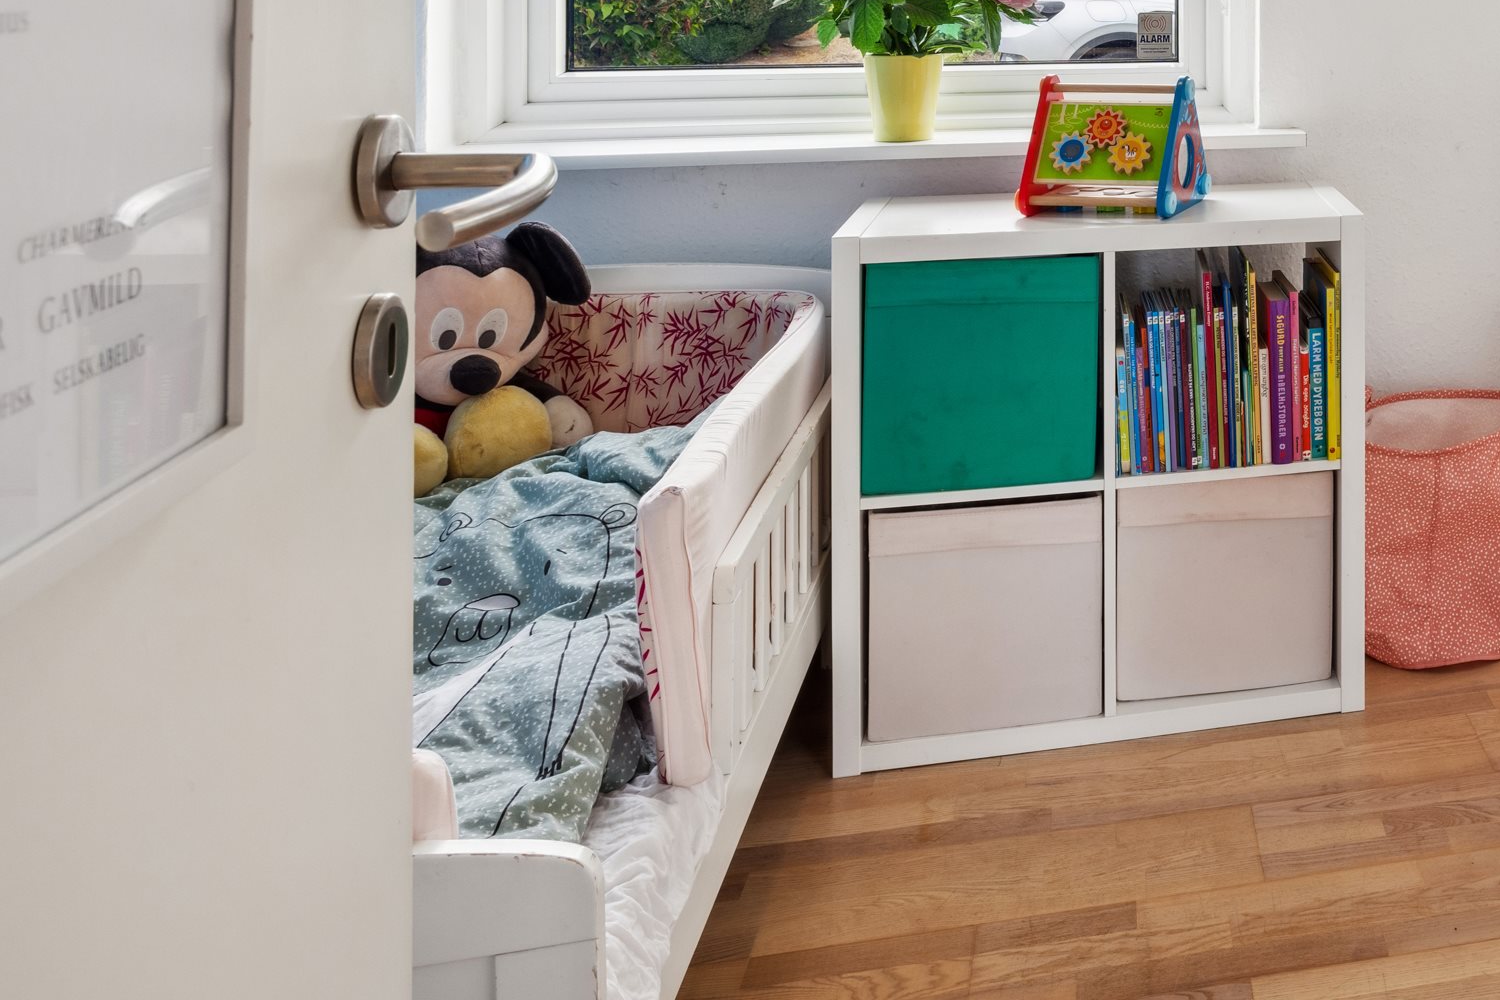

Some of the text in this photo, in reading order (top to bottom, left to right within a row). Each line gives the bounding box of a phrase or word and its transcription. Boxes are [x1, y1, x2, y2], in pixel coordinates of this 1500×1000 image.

[1140, 34, 1170, 44] ALARM
[36, 266, 143, 334] GAVMILD
[53, 333, 146, 395] SELSKABELIG
[1312, 332, 1324, 440] LARM MED DYREBØRN
[1278, 375, 1286, 438] BIBELHISTORIER
